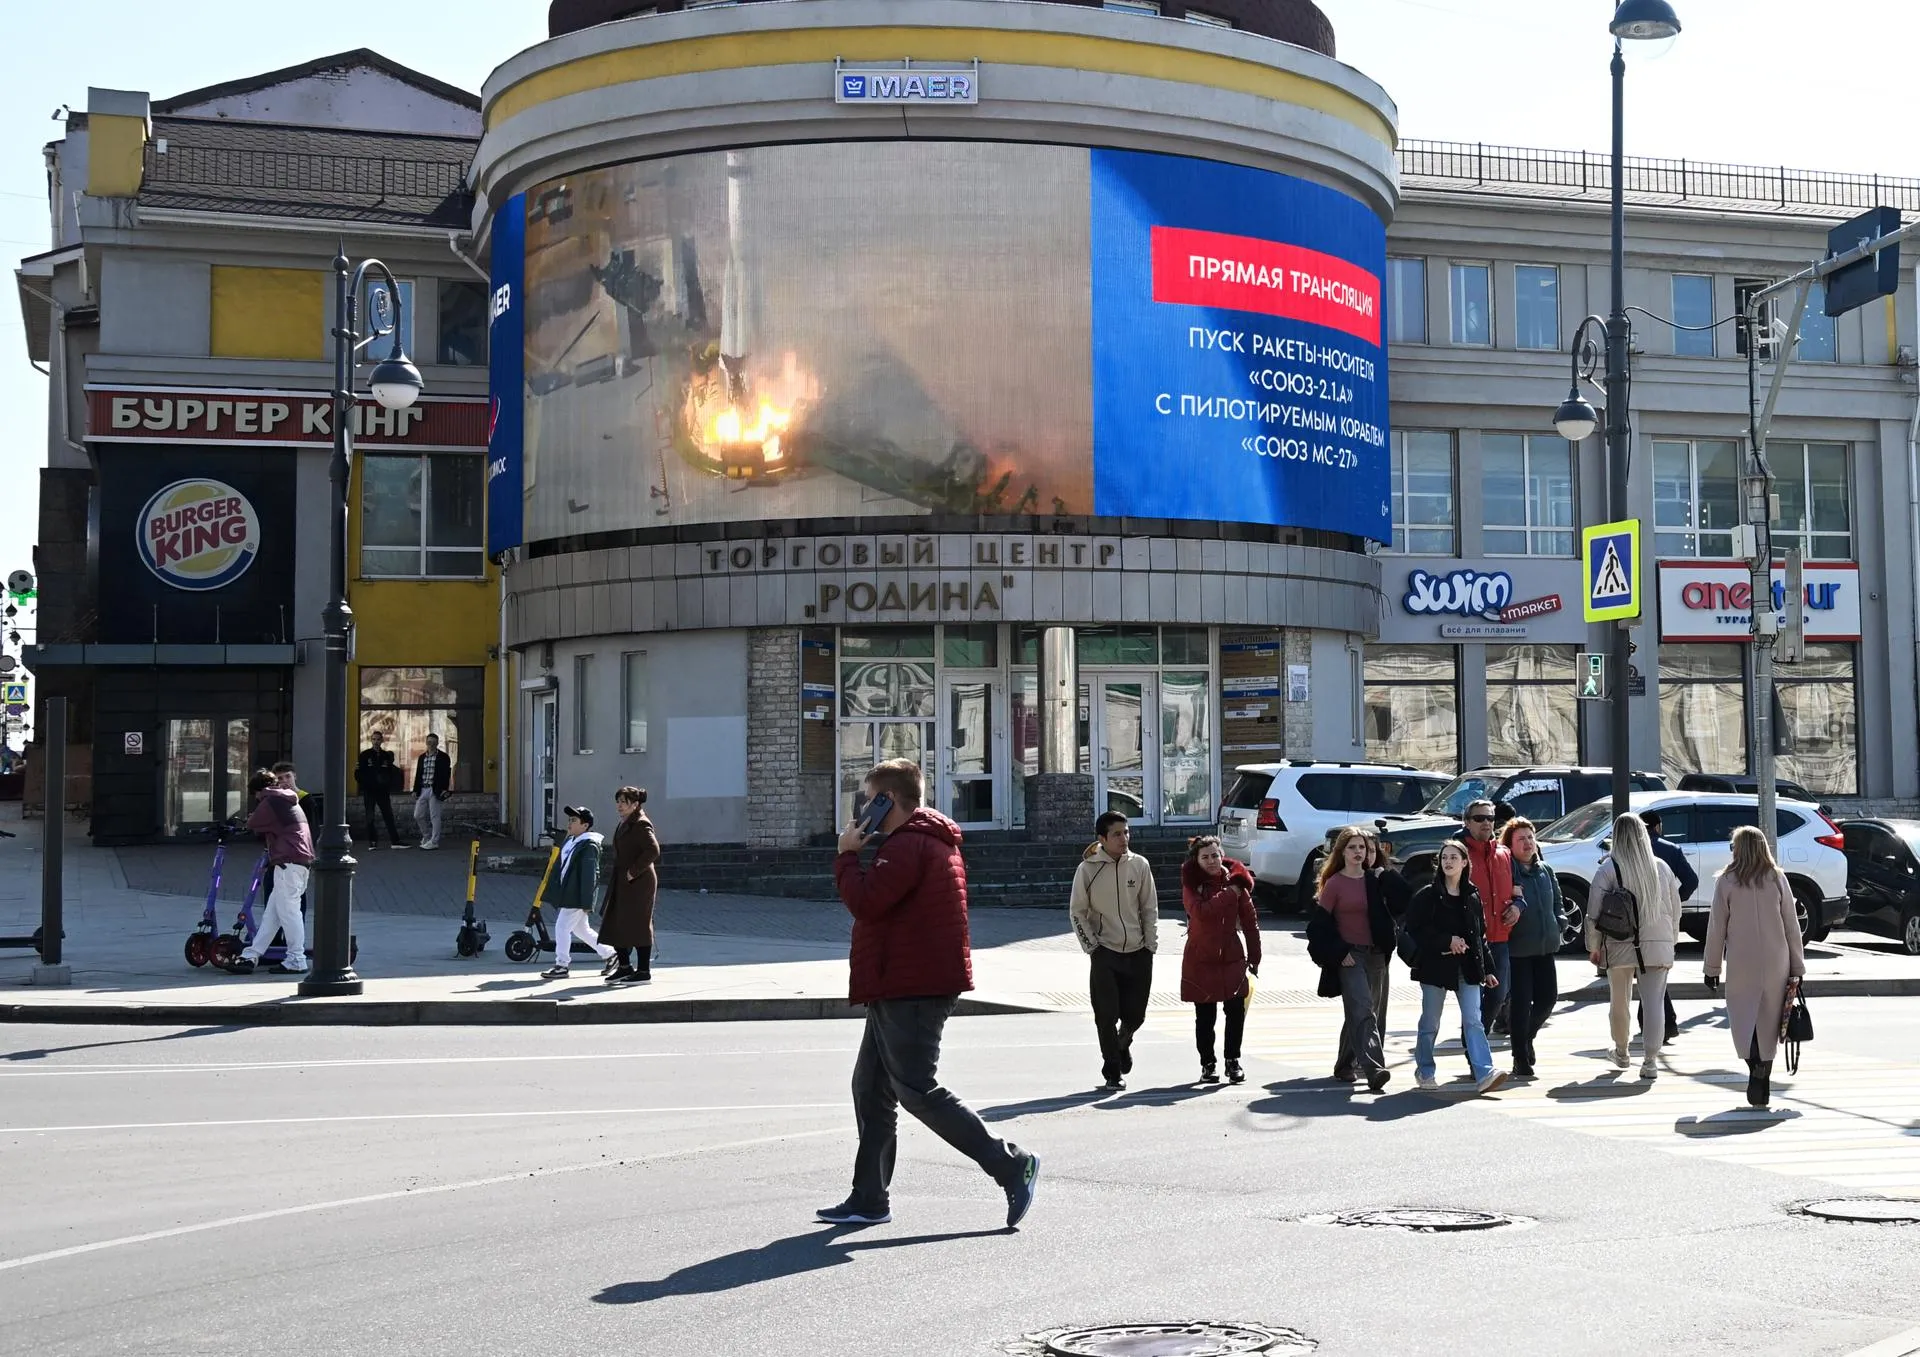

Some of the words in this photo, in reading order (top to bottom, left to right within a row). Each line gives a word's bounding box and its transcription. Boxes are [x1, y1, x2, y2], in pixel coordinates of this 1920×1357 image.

[871, 75, 970, 98] MAER
[1189, 255, 1283, 290] ПРЯМАЯ
[1289, 270, 1373, 318] ТРАНСЛЯЦИЯ
[1189, 327, 1245, 354] ПУСК
[1253, 334, 1375, 383] РАКЕТЫ-НОСИТЕЛЯ
[1249, 369, 1354, 405] «СОЮЗ-2.1.А»
[111, 397, 290, 433] БУРГЕР
[1155, 393, 1171, 415] С
[1181, 394, 1337, 433] ПИЛОТИРУЕМЫМ
[1340, 416, 1385, 448] КОРАБЛЕМ
[1241, 435, 1308, 462] «СОЮЗ
[1312, 442, 1358, 470] МС-27»
[150, 497, 242, 540] BURGER
[155, 516, 247, 568] KING
[706, 536, 934, 570] ТОРГОВЫЙ
[976, 542, 1115, 566] ЦЕНТР
[1465, 627, 1481, 635] для
